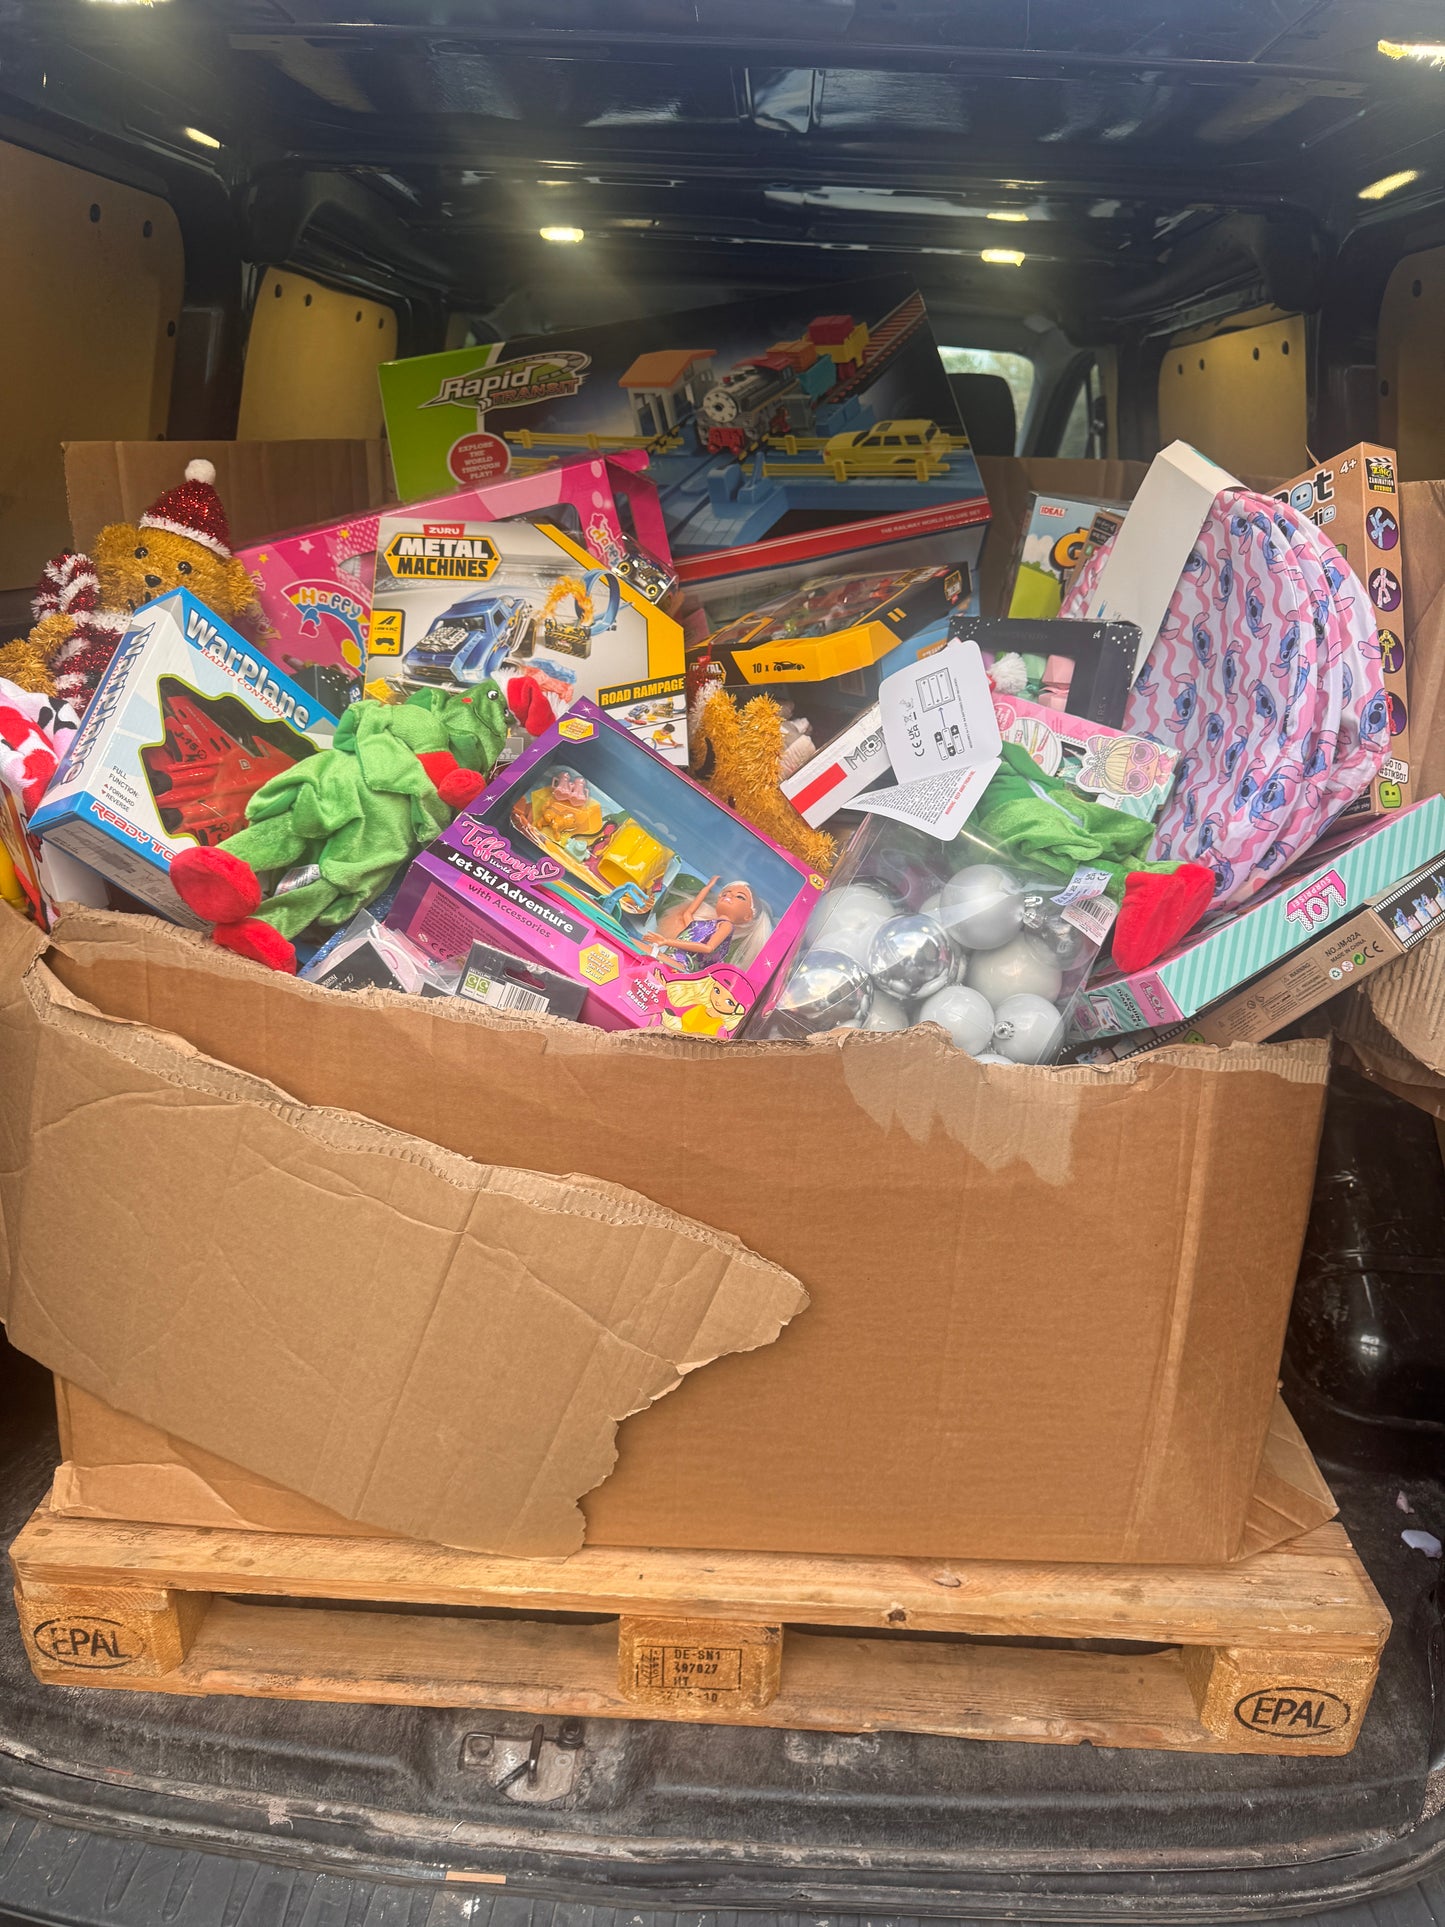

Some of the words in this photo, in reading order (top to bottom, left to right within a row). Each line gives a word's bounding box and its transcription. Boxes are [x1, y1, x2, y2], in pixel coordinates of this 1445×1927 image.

[448, 364, 540, 404] Rapid
[490, 378, 580, 404] TRANSIT
[458, 441, 494, 453] EXPLORE
[470, 450, 486, 458] THE
[462, 461, 501, 474] THROUGH
[464, 456, 494, 466] WORLD
[1339, 459, 1357, 475] 4+
[470, 470, 493, 480] PLAY!
[1041, 505, 1064, 517] IDEAL
[428, 526, 461, 535] ZURU
[398, 537, 489, 559] METAL
[397, 557, 489, 577] MACHINES
[300, 587, 362, 619] Happy
[752, 662, 762, 674] 10
[200, 647, 237, 679] RADIO
[237, 676, 286, 719] CONTROL
[600, 688, 632, 706] ROAD
[633, 677, 685, 699] RAMPAGE
[112, 765, 128, 780] FULL
[1394, 762, 1402, 770] TO
[108, 774, 139, 799] FUNCTION:
[108, 786, 135, 808] FORWARD
[105, 793, 131, 813] REVERSE
[461, 820, 541, 882] Tiffany's
[489, 859, 512, 874] World
[447, 852, 474, 872] Jet
[472, 866, 499, 887] Ski
[496, 882, 574, 934] Adventure
[1291, 876, 1332, 908] SURPRISE!
[468, 883, 492, 902] with
[493, 900, 551, 939] Accessories
[1330, 952, 1345, 963] MADE
[1350, 938, 1366, 951] CHINA
[634, 978, 652, 996] Head
[651, 993, 660, 1004] To
[636, 989, 648, 1003] The
[644, 978, 660, 995] Let's
[626, 990, 649, 1012] Beach!
[51, 1627, 132, 1658] EPAL
[1252, 1697, 1331, 1729] EPAL
